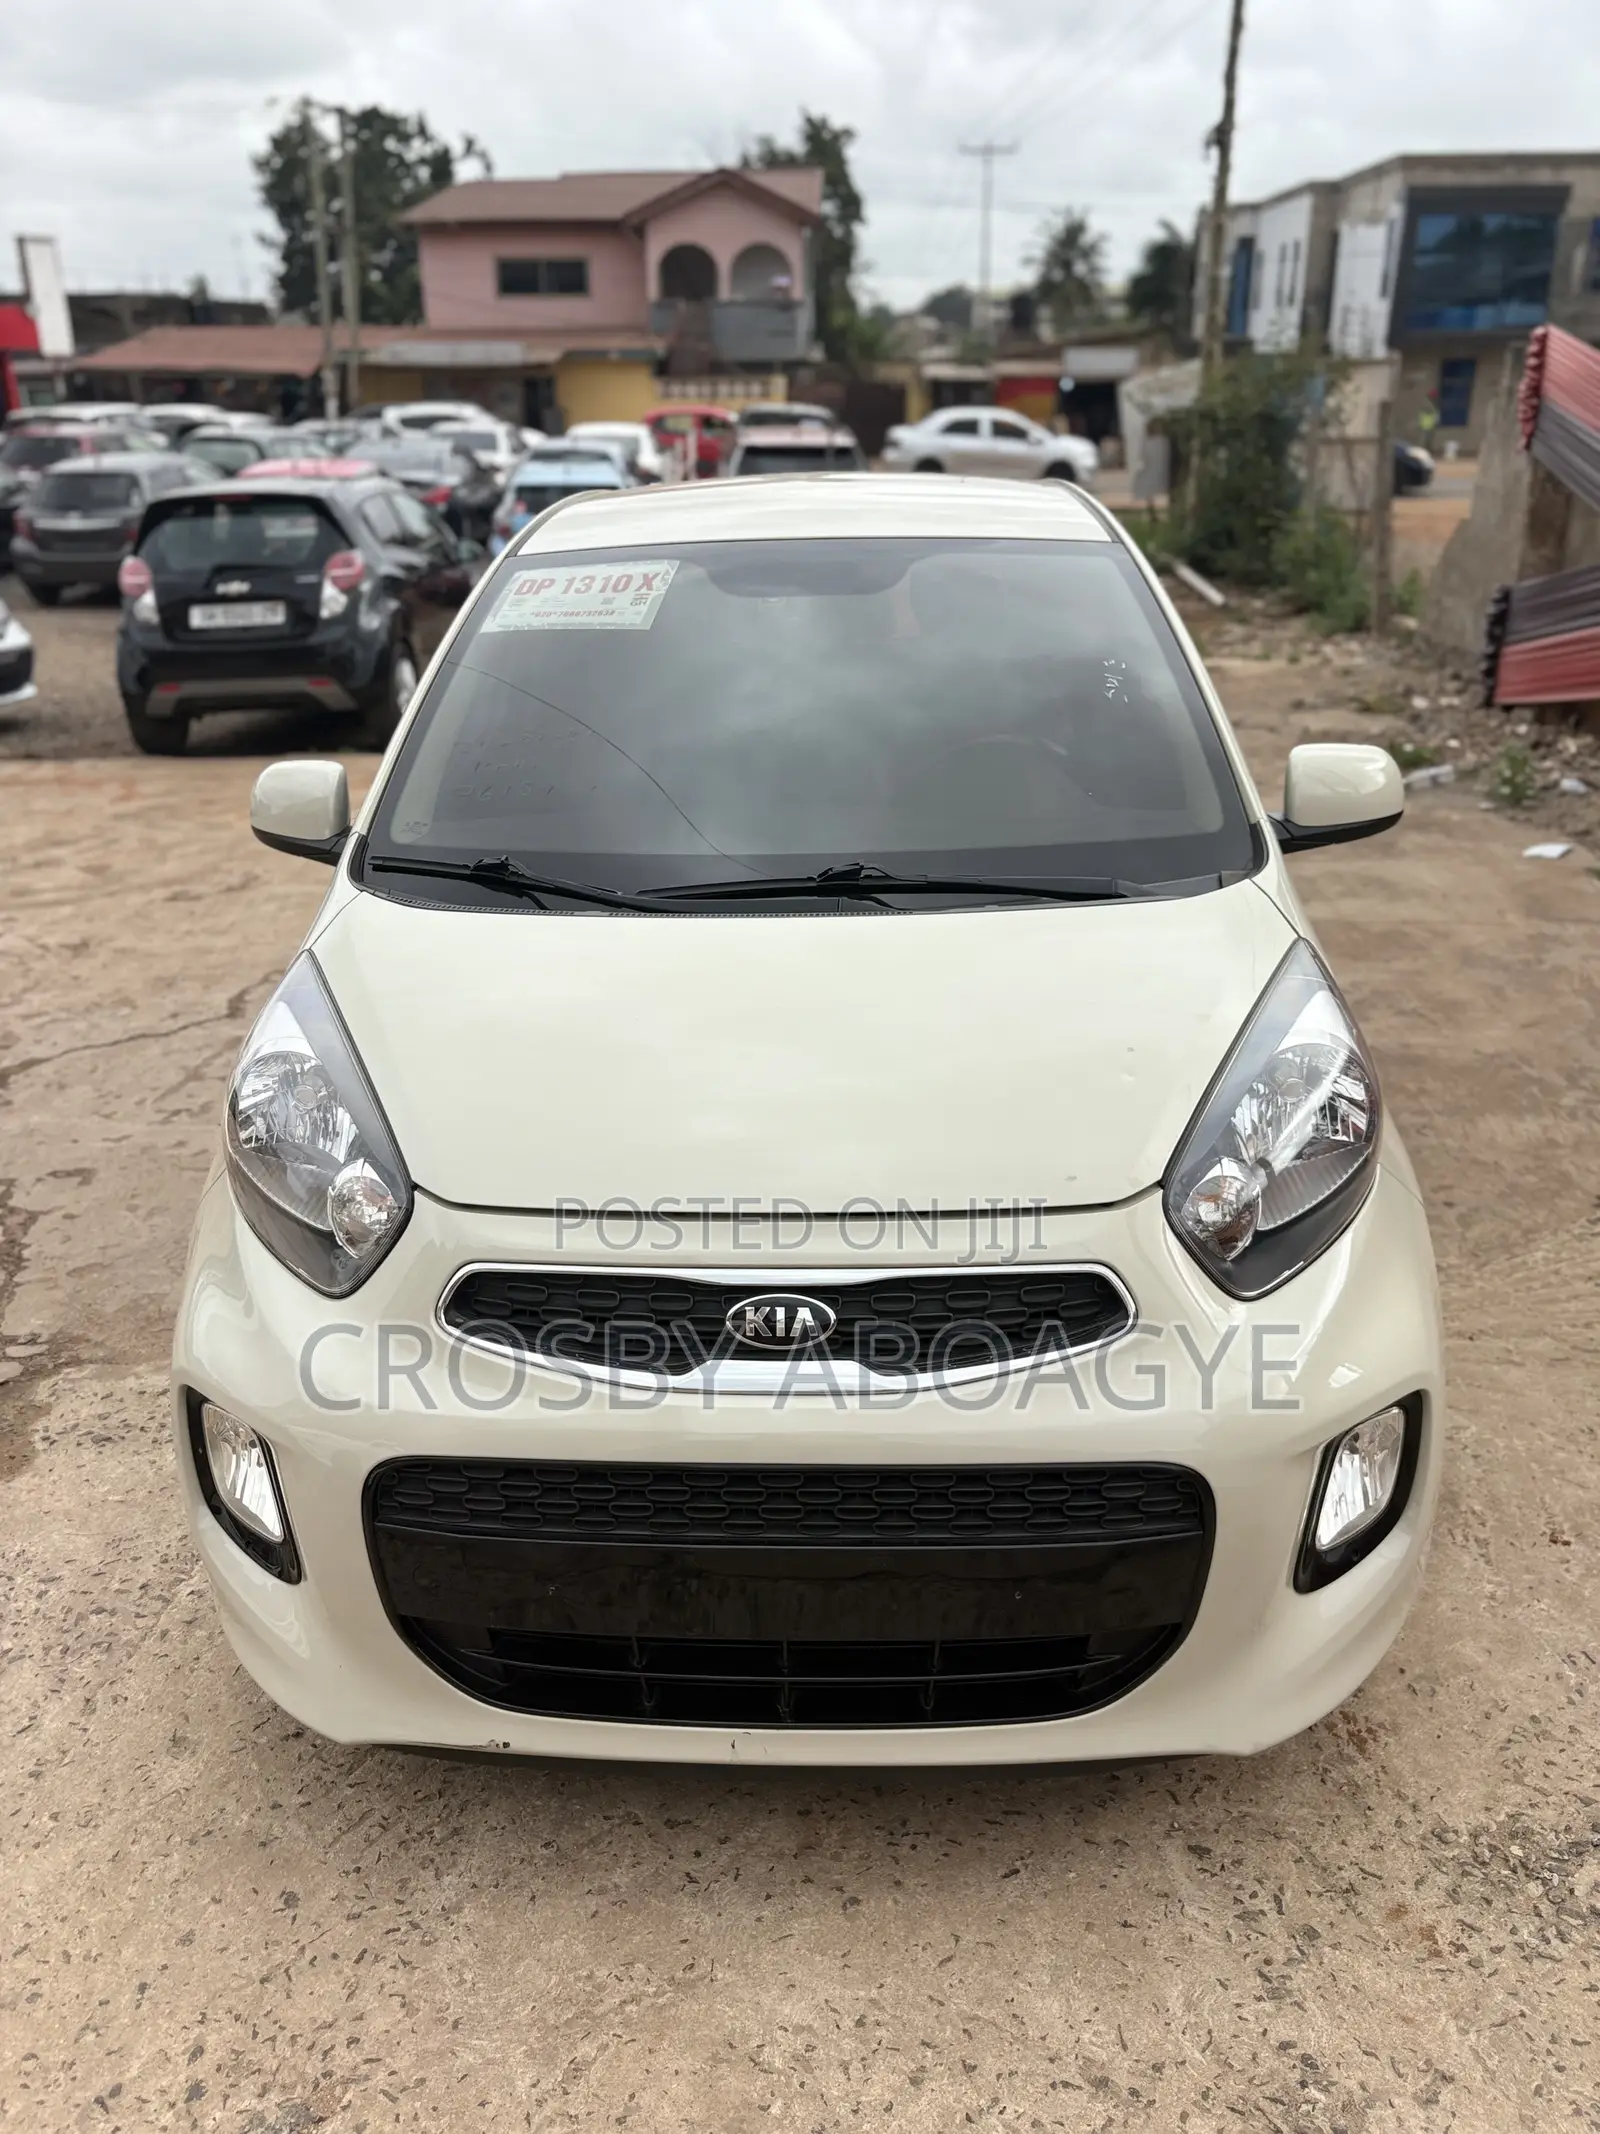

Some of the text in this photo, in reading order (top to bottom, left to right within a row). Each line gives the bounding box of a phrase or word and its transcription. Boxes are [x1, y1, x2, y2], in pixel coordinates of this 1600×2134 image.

[515, 572, 660, 596] DP 1310 X
[744, 1306, 819, 1337] KIA
